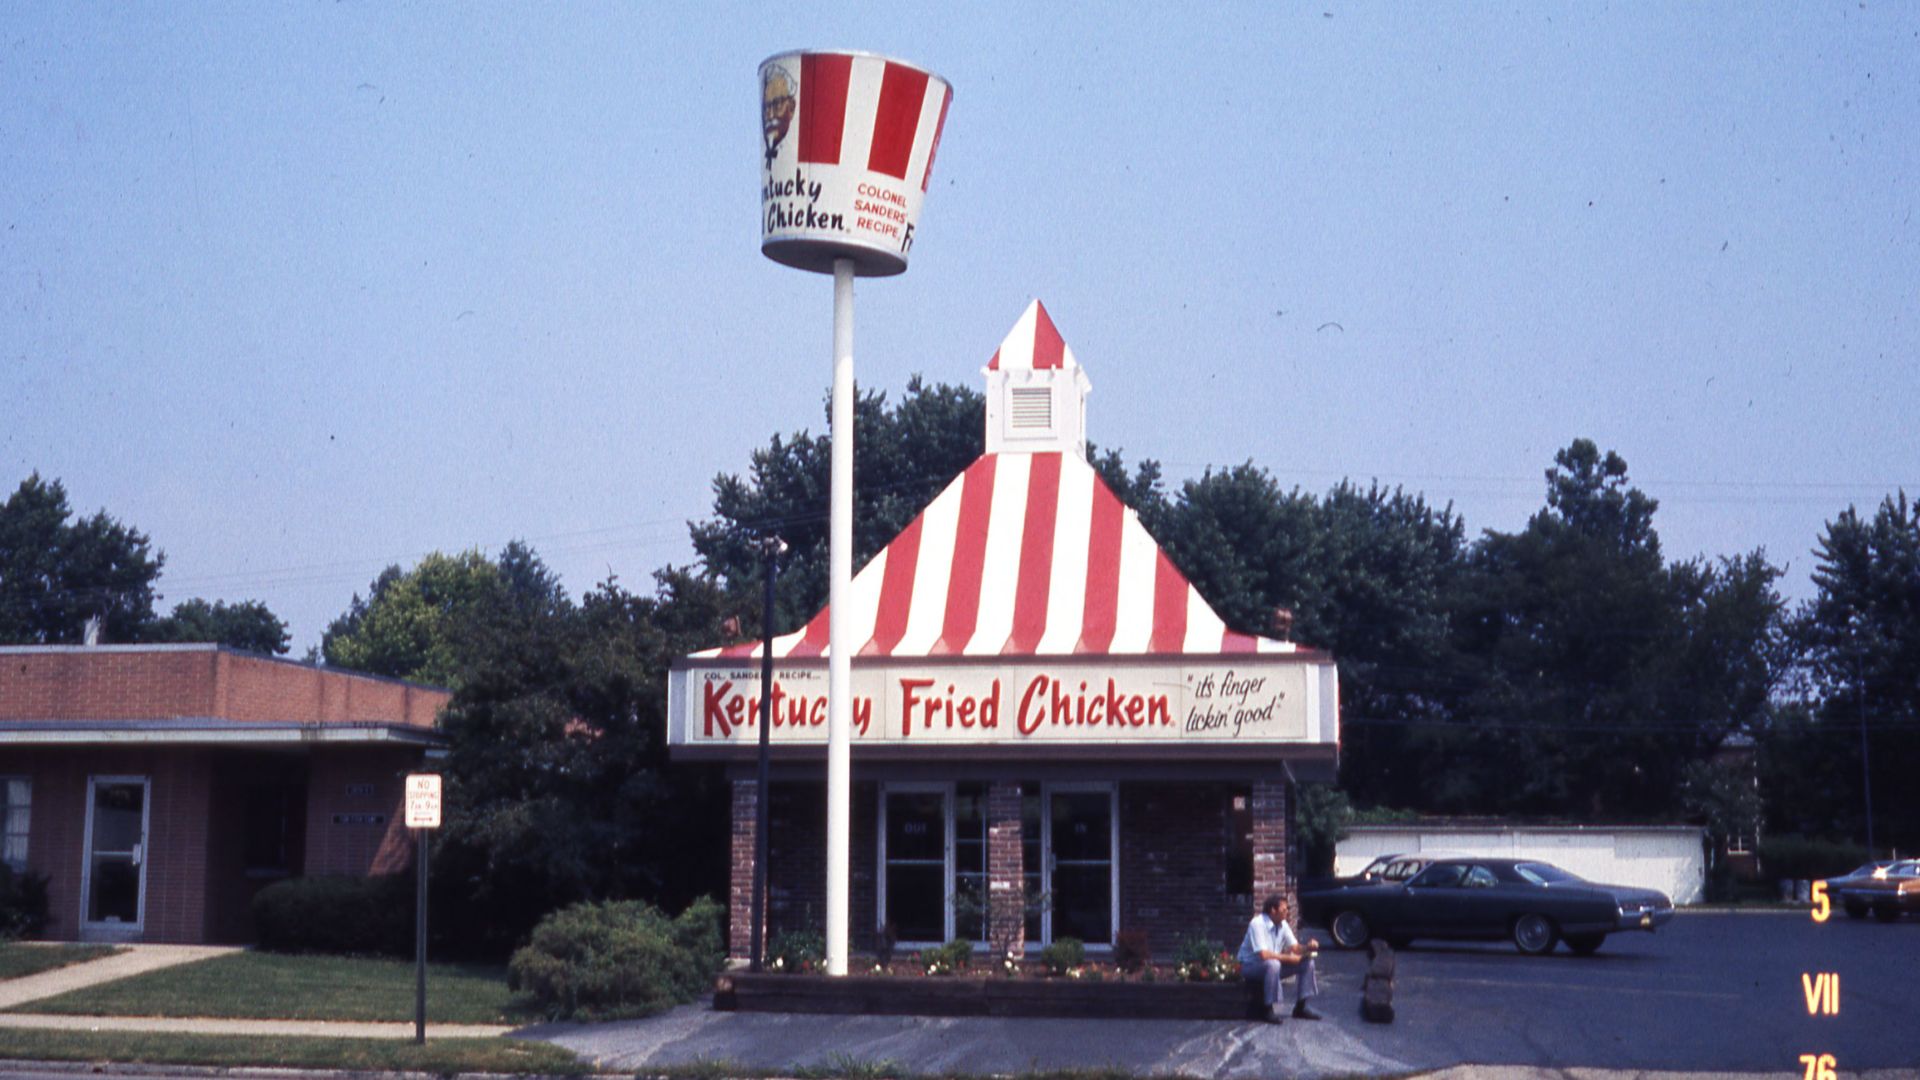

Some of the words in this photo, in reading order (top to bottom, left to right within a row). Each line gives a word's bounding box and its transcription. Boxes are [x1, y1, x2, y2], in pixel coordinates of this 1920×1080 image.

[857, 183, 907, 208] COLONEL
[730, 671, 766, 680] SANDE
[1220, 670, 1266, 706] finger
[703, 679, 872, 738] Kentucy
[900, 678, 1001, 737] Fried
[417, 780, 430, 790] NO
